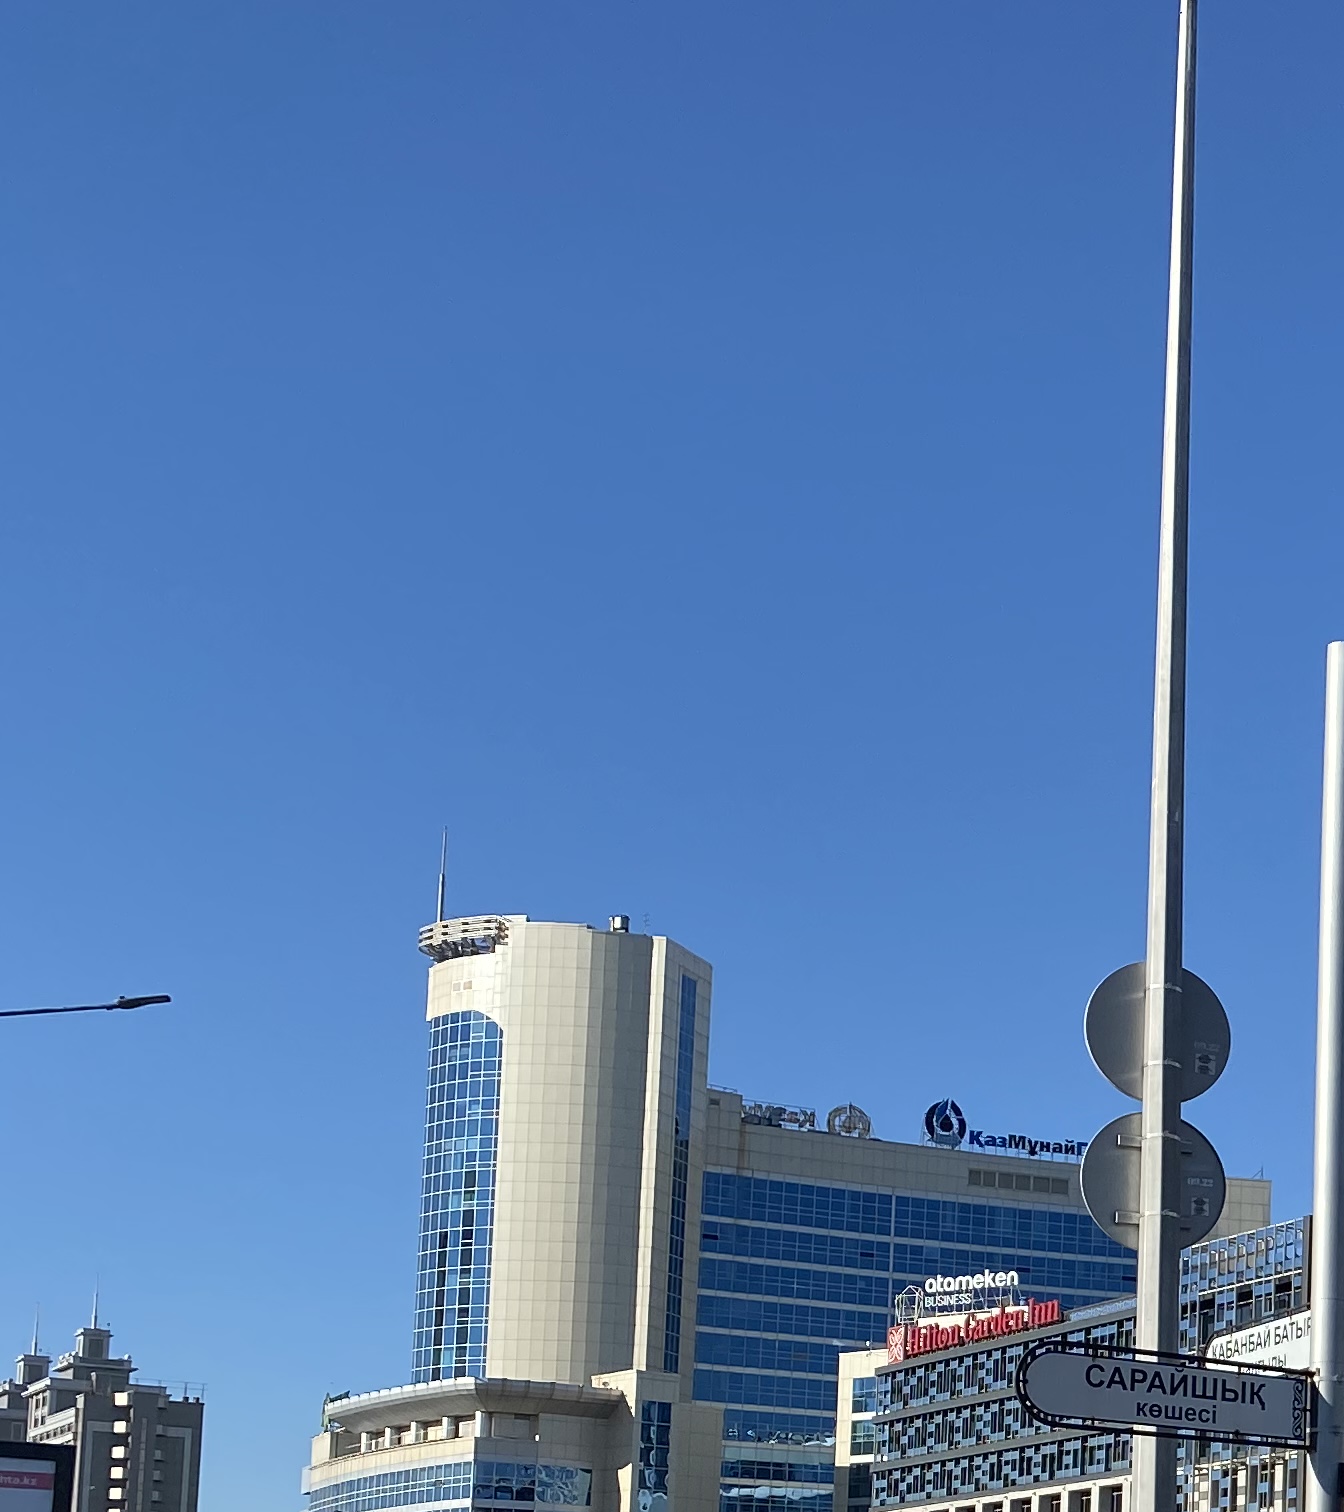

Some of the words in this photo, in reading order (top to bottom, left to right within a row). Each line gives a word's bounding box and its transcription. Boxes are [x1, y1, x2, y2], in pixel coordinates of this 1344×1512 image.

[924, 1269, 1018, 1293] atameken
[924, 1292, 972, 1308] BUSINESS
[907, 1323, 959, 1356] Hilton
[963, 1305, 1024, 1341] Garden
[1028, 1297, 1062, 1327] Inn
[1085, 1363, 1267, 1411] САРАЙШЫҚ
[1135, 1401, 1217, 1424] көшесі
